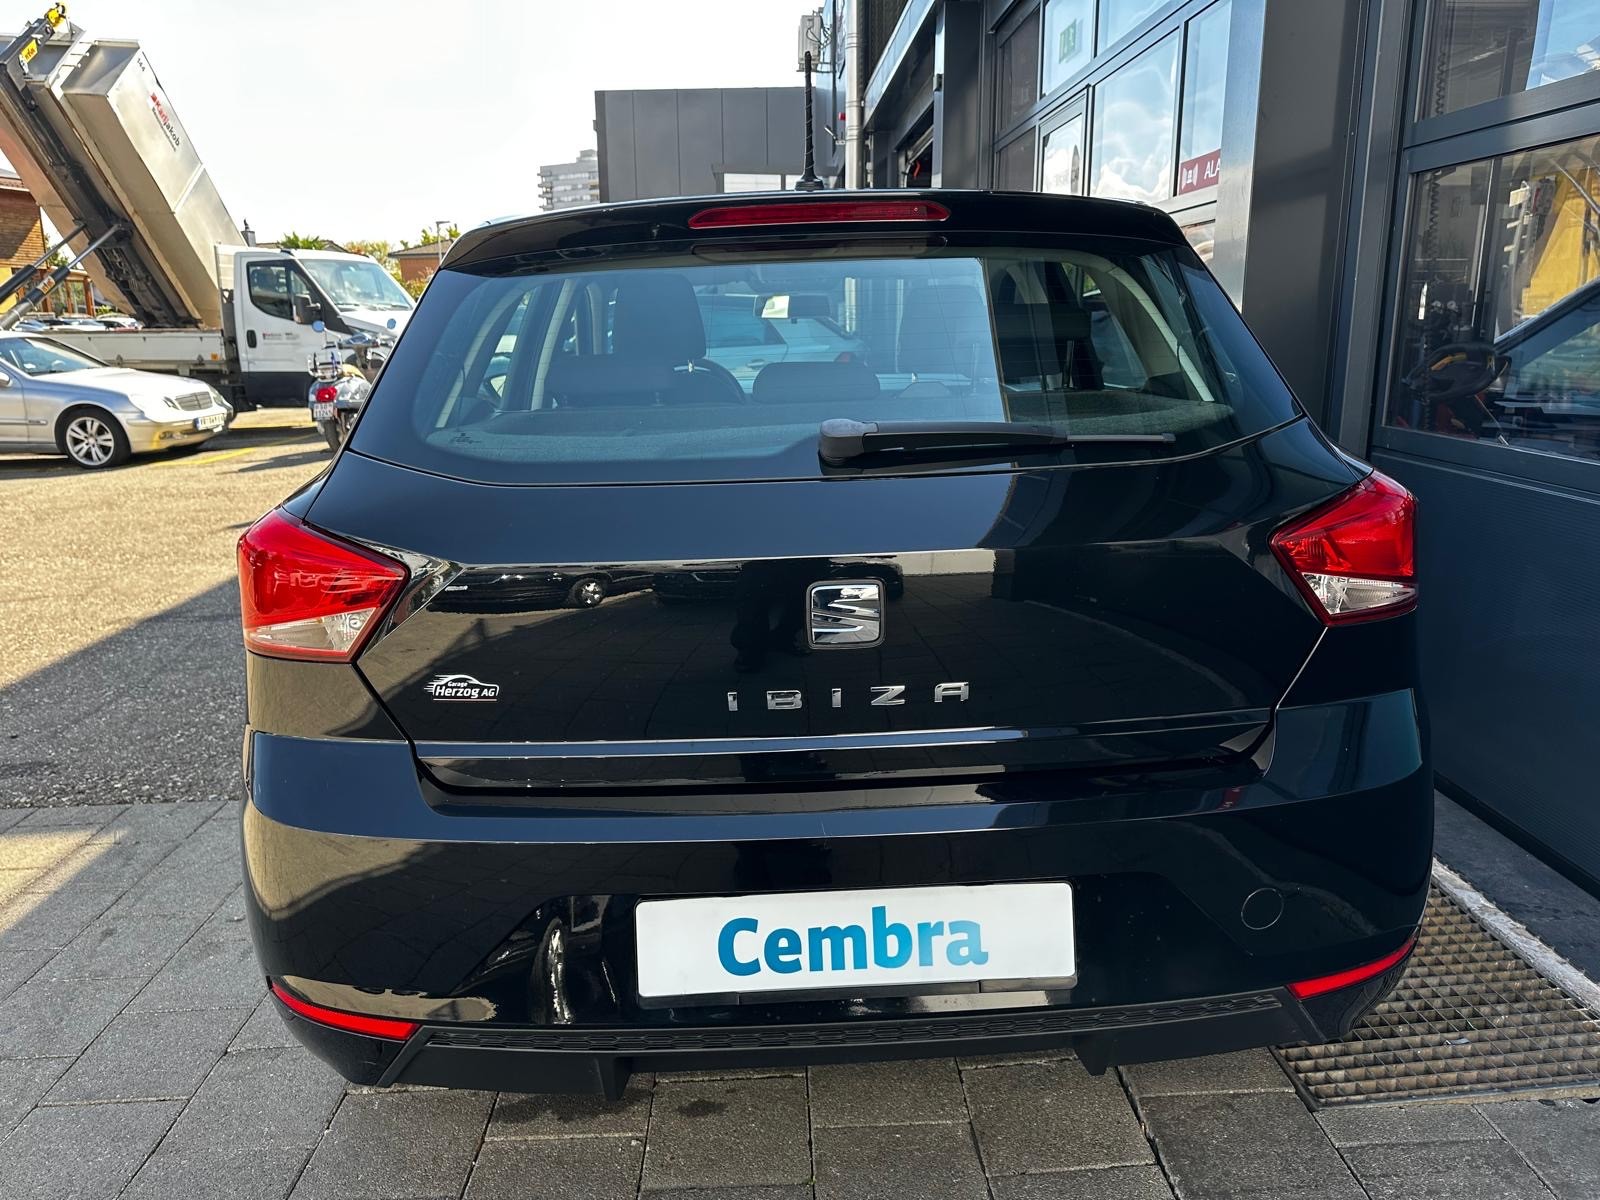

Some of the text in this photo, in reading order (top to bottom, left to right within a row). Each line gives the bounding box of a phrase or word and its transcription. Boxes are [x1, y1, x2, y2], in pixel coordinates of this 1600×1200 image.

[435, 686, 496, 698] Herzog AG
[727, 682, 969, 711] IBIZA
[718, 906, 989, 976] Cembra
